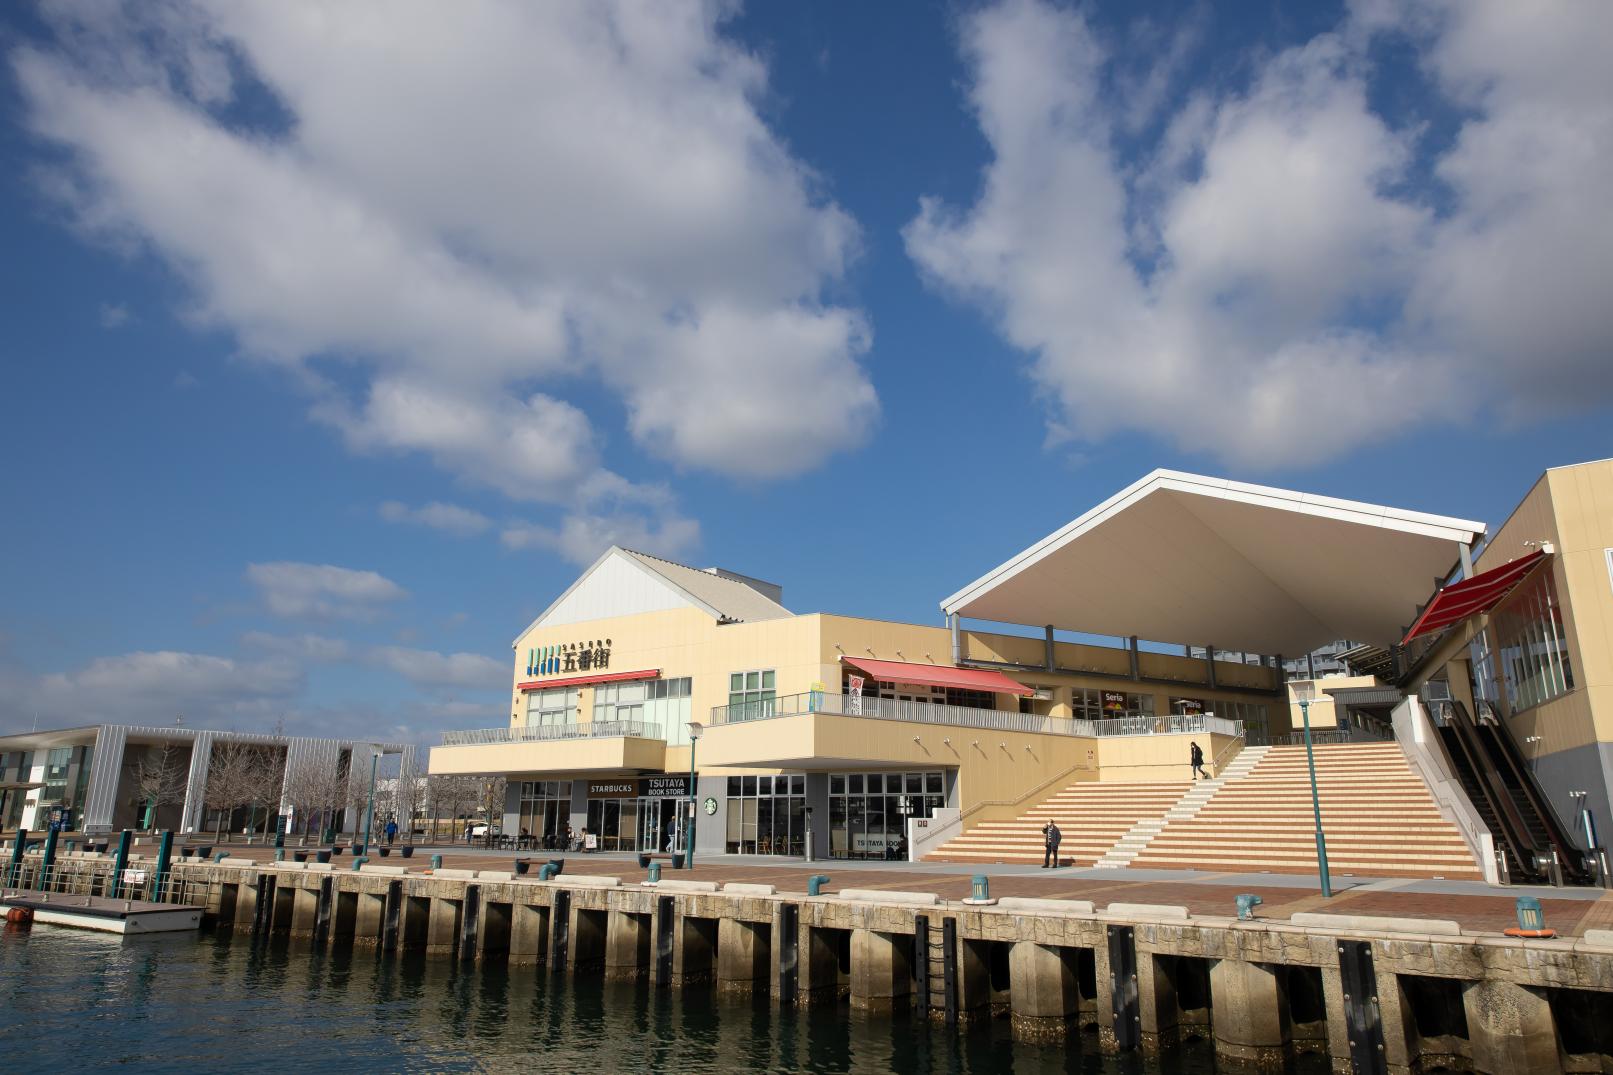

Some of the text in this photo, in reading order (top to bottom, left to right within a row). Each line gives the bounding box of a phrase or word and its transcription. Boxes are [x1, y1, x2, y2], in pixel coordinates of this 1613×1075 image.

[561, 648, 611, 673] 五番街
[1105, 693, 1123, 702] Seria
[648, 778, 685, 788] TSUTAYA
[591, 784, 632, 793] STARBUCKS
[648, 788, 685, 796] BOOK STORE
